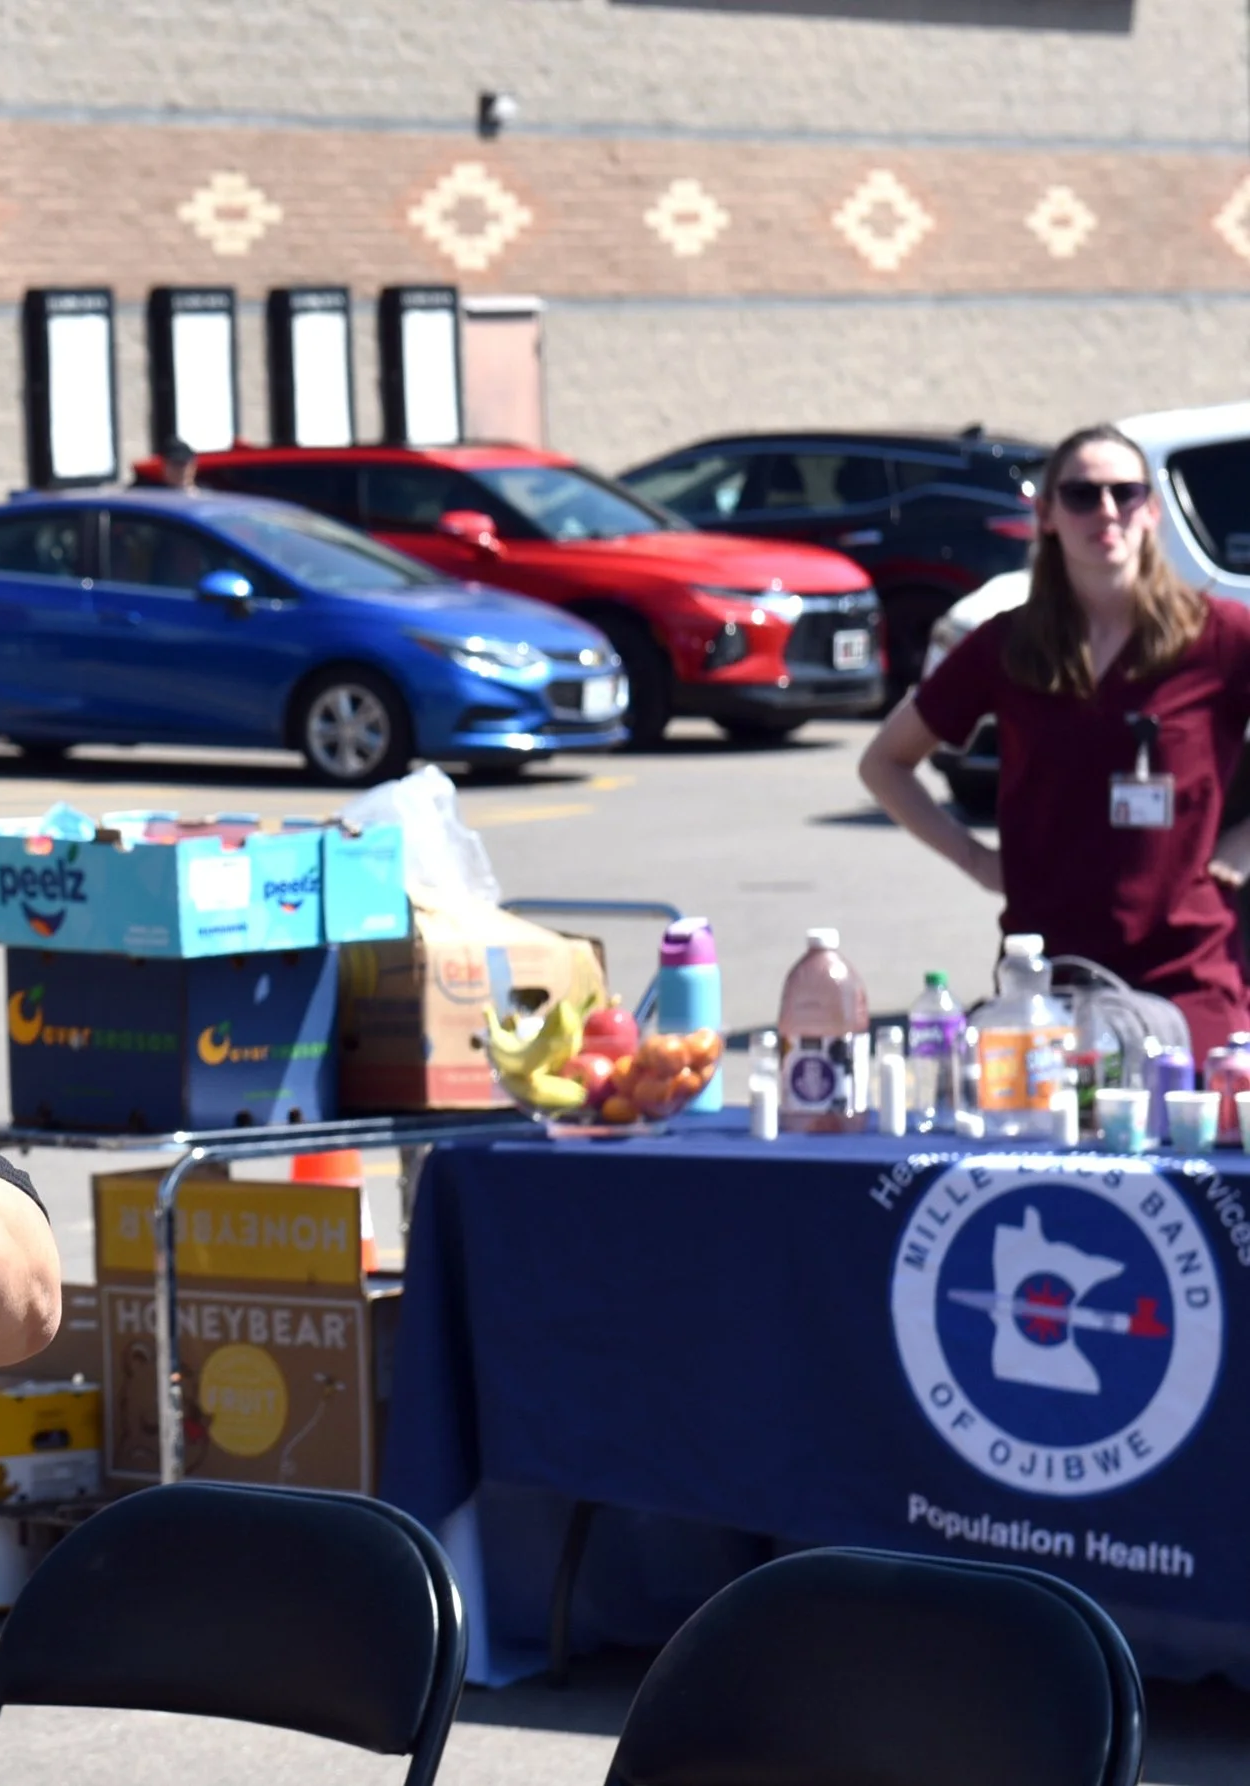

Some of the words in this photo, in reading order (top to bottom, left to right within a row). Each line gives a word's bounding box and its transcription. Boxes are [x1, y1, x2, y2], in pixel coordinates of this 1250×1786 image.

[902, 1165, 994, 1273] MILLE
[1138, 1189, 1212, 1311] BAND
[929, 1382, 976, 1433] OF
[988, 1430, 1153, 1482] OJIBWE
[906, 1493, 1076, 1558] Population
[1084, 1529, 1196, 1578] Health
